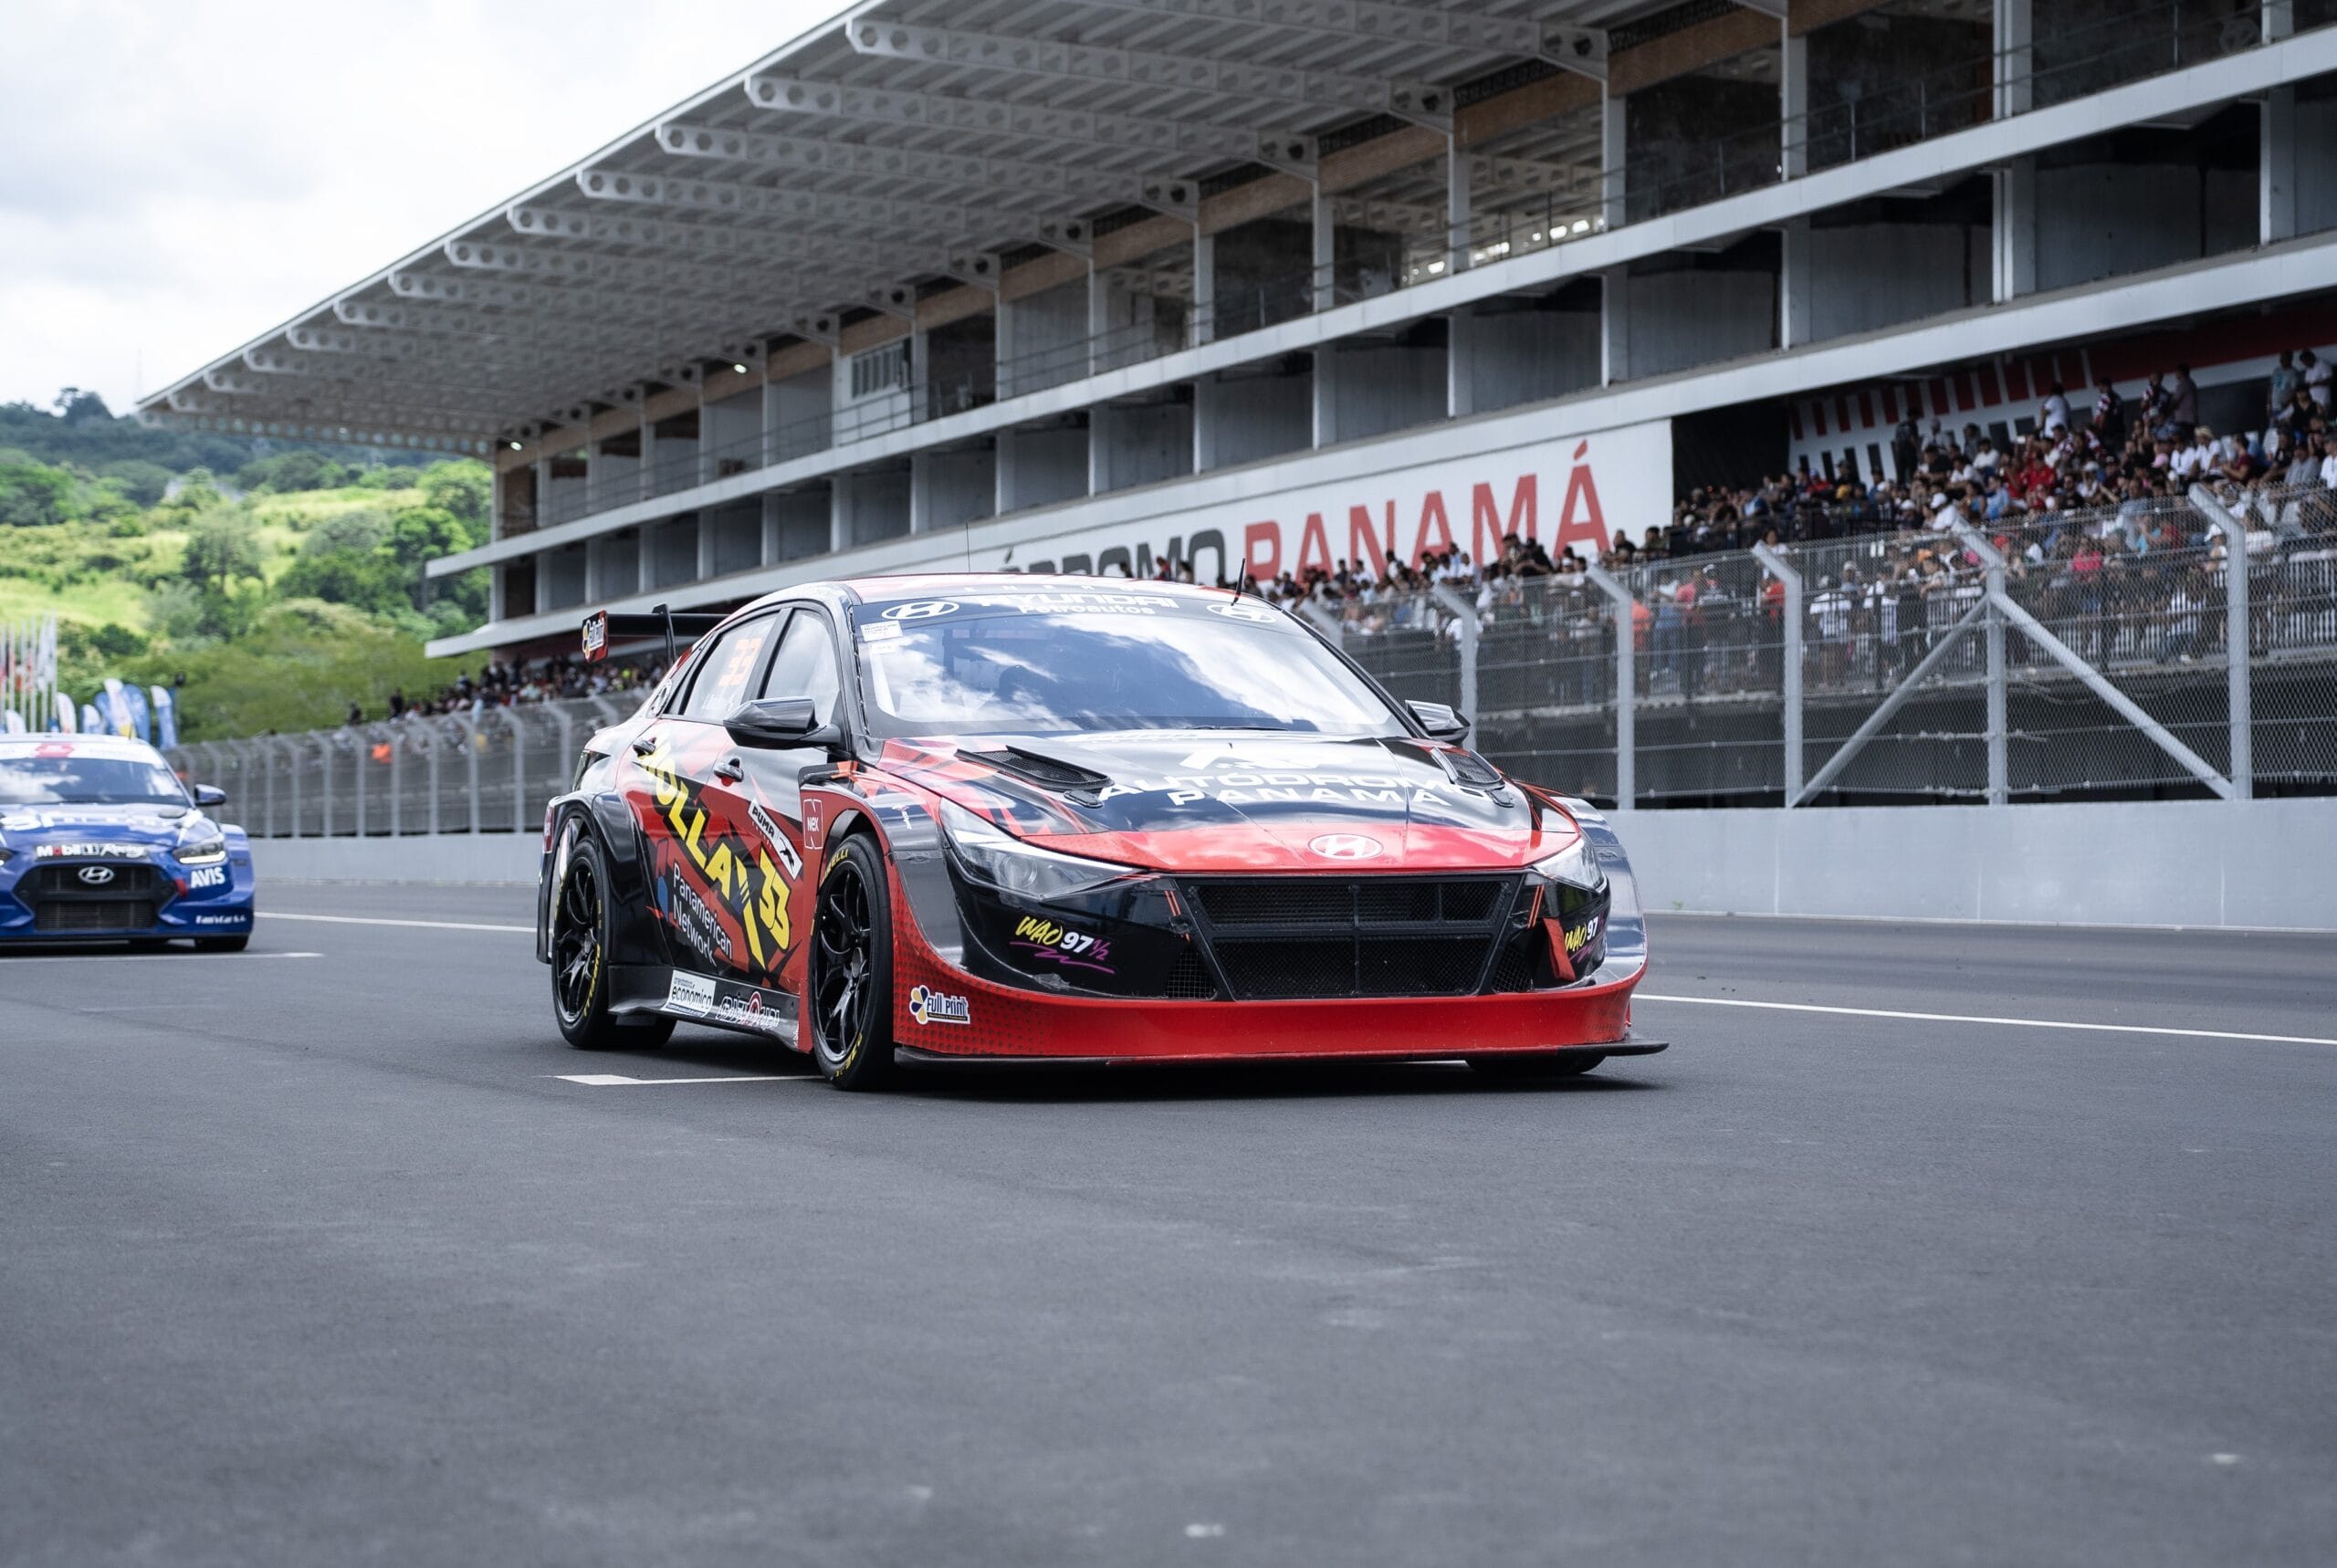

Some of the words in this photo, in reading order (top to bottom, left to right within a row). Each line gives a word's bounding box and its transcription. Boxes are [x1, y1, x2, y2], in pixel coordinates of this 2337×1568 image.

[1245, 439, 1611, 586] PANAMÁ
[973, 593, 1179, 609] HYUNDAI
[1018, 603, 1156, 615] Petroautos
[752, 806, 775, 839] PUMA
[37, 843, 80, 858] Mobil
[190, 867, 226, 888] AVIS
[674, 862, 732, 959] Panamerican
[760, 847, 791, 950] 33
[674, 894, 717, 967] Network
[1015, 915, 1064, 946] WAO
[1565, 925, 1587, 952] WAO
[946, 998, 968, 1017] Print
